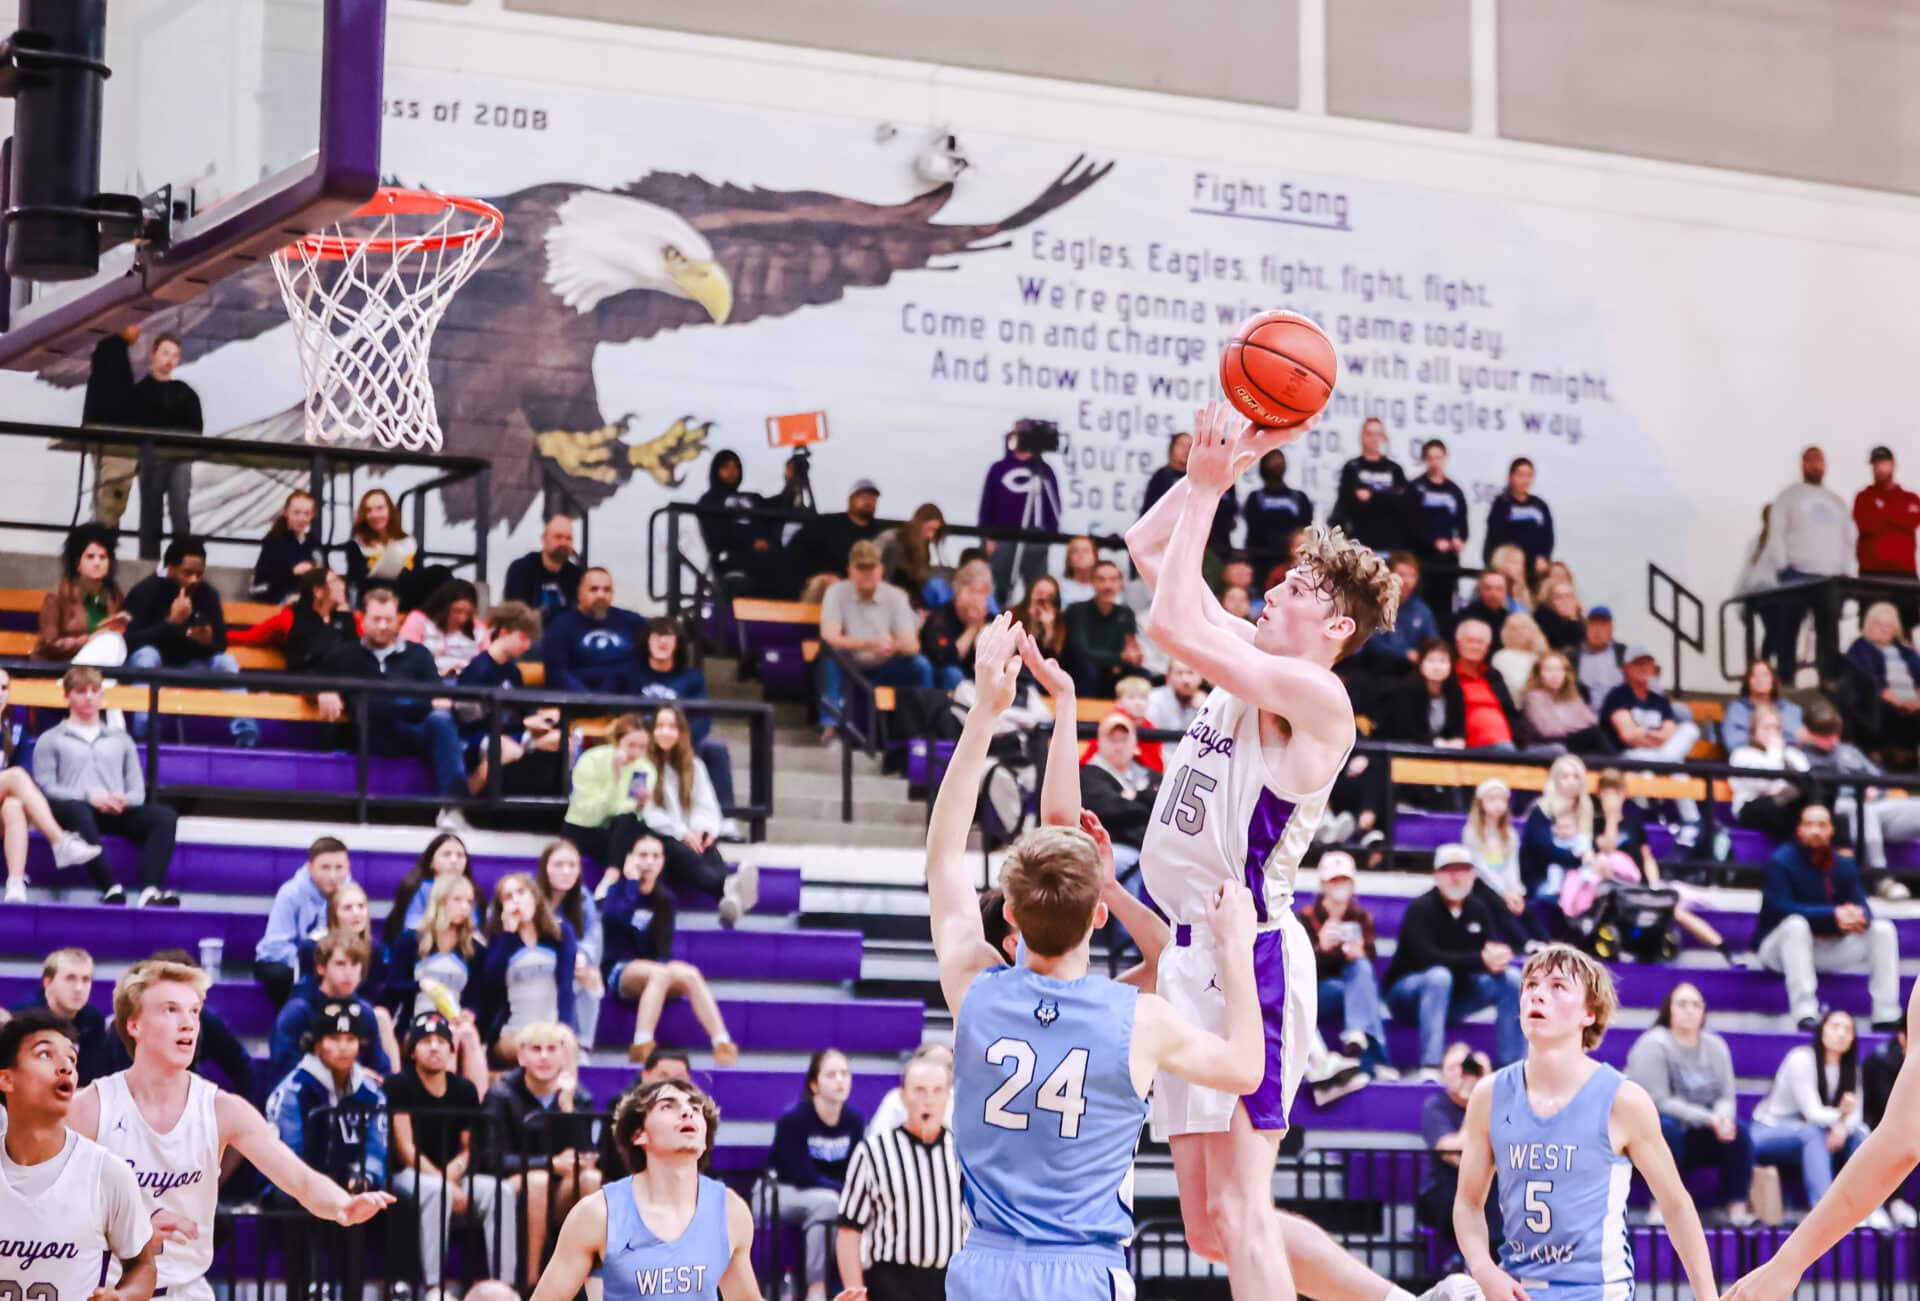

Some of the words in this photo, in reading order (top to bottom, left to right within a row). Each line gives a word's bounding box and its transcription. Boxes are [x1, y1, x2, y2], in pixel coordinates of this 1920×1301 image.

[432, 101, 462, 124] of
[1194, 173, 1267, 213] Fight
[1280, 184, 1347, 227] Song
[1017, 276, 1107, 314] We're
[1116, 292, 1206, 324] gonna
[1336, 314, 1412, 345] game
[901, 302, 986, 341] Come
[998, 319, 1036, 346] on
[1044, 323, 1098, 351] and
[1106, 324, 1206, 367] charge
[1343, 353, 1409, 381] with
[1415, 356, 1450, 385] all
[1457, 364, 1518, 395] your
[931, 349, 990, 384] And
[1001, 355, 1080, 391] show
[1091, 364, 1137, 397] the
[1150, 374, 1223, 403] worl
[1160, 764, 1218, 836] 15
[984, 1037, 1090, 1139] 24
[1508, 1143, 1578, 1171] WEST
[1524, 1180, 1554, 1235] 5
[636, 1265, 707, 1296] WEST
